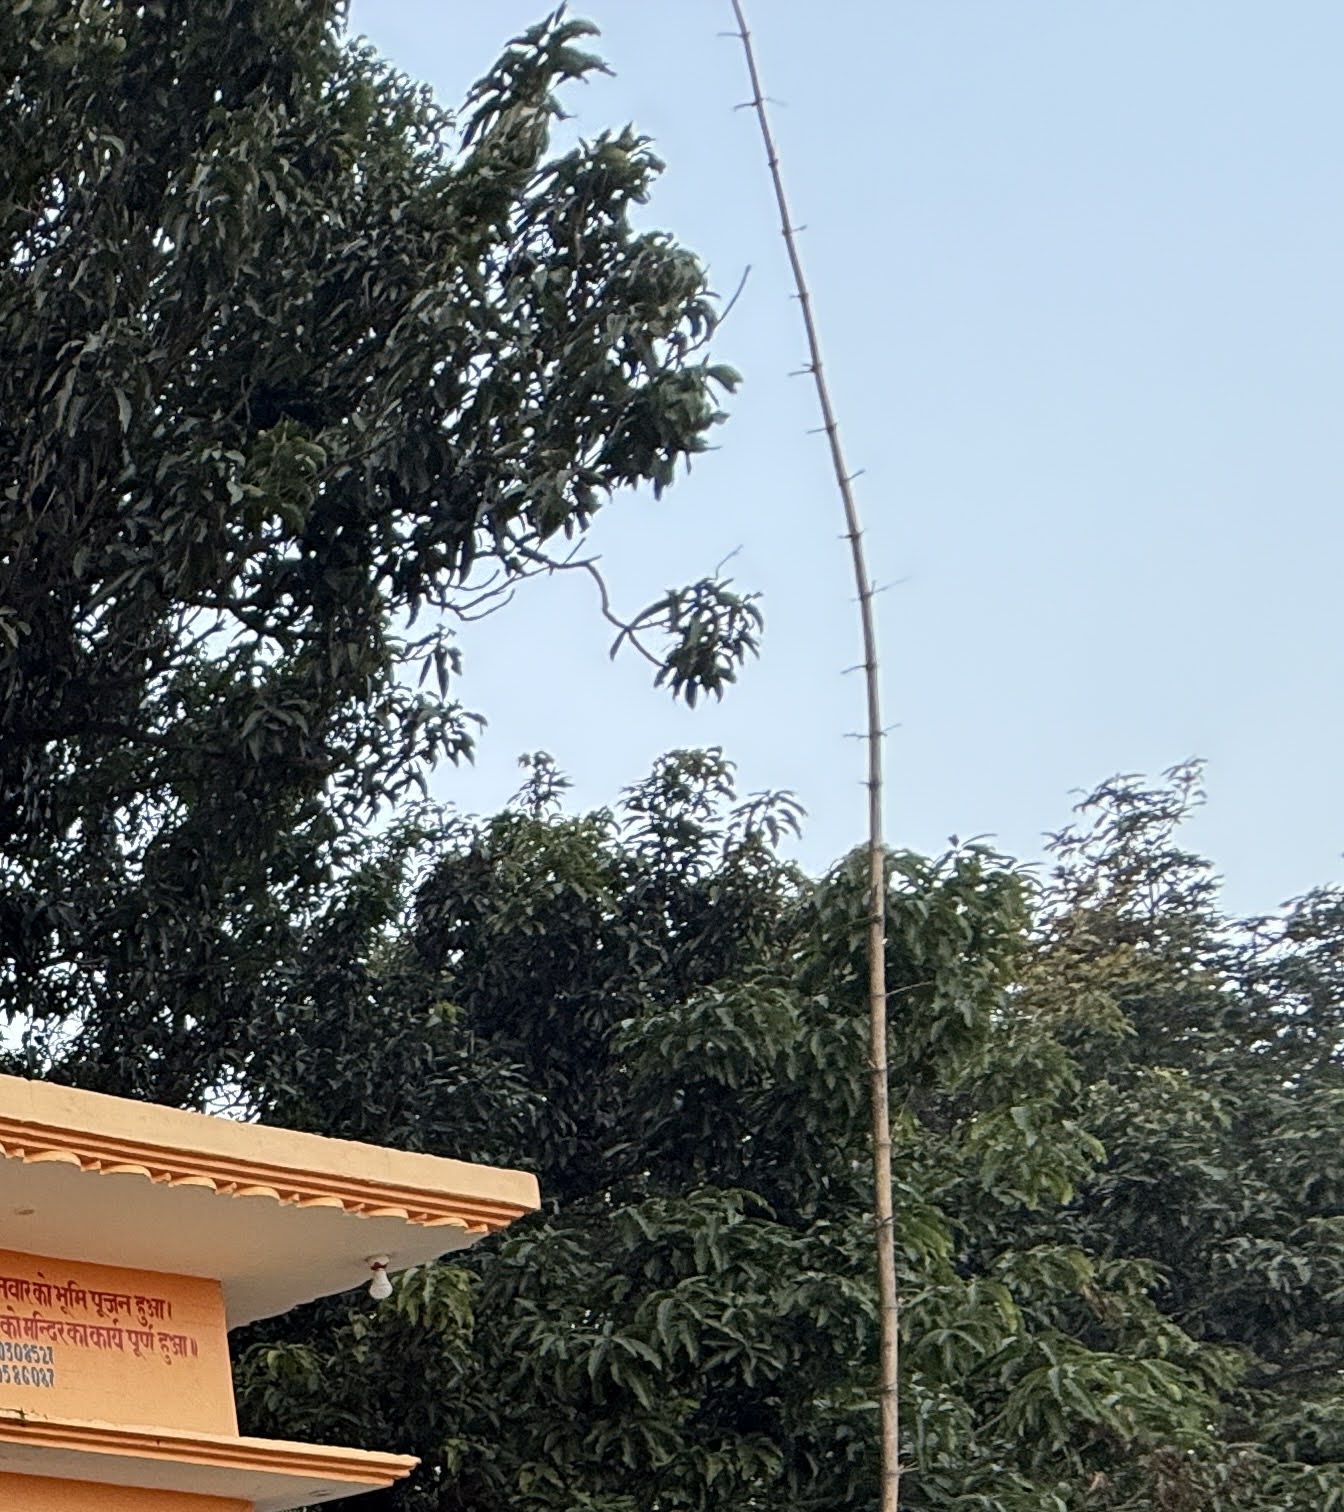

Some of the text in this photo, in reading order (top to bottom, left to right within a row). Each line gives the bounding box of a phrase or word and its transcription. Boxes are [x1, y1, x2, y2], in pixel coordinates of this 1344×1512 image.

[32, 1271, 53, 1307] को
[53, 1280, 87, 1318] भूमि
[0, 1305, 21, 1340] को
[22, 1310, 67, 1345] मन्दिर
